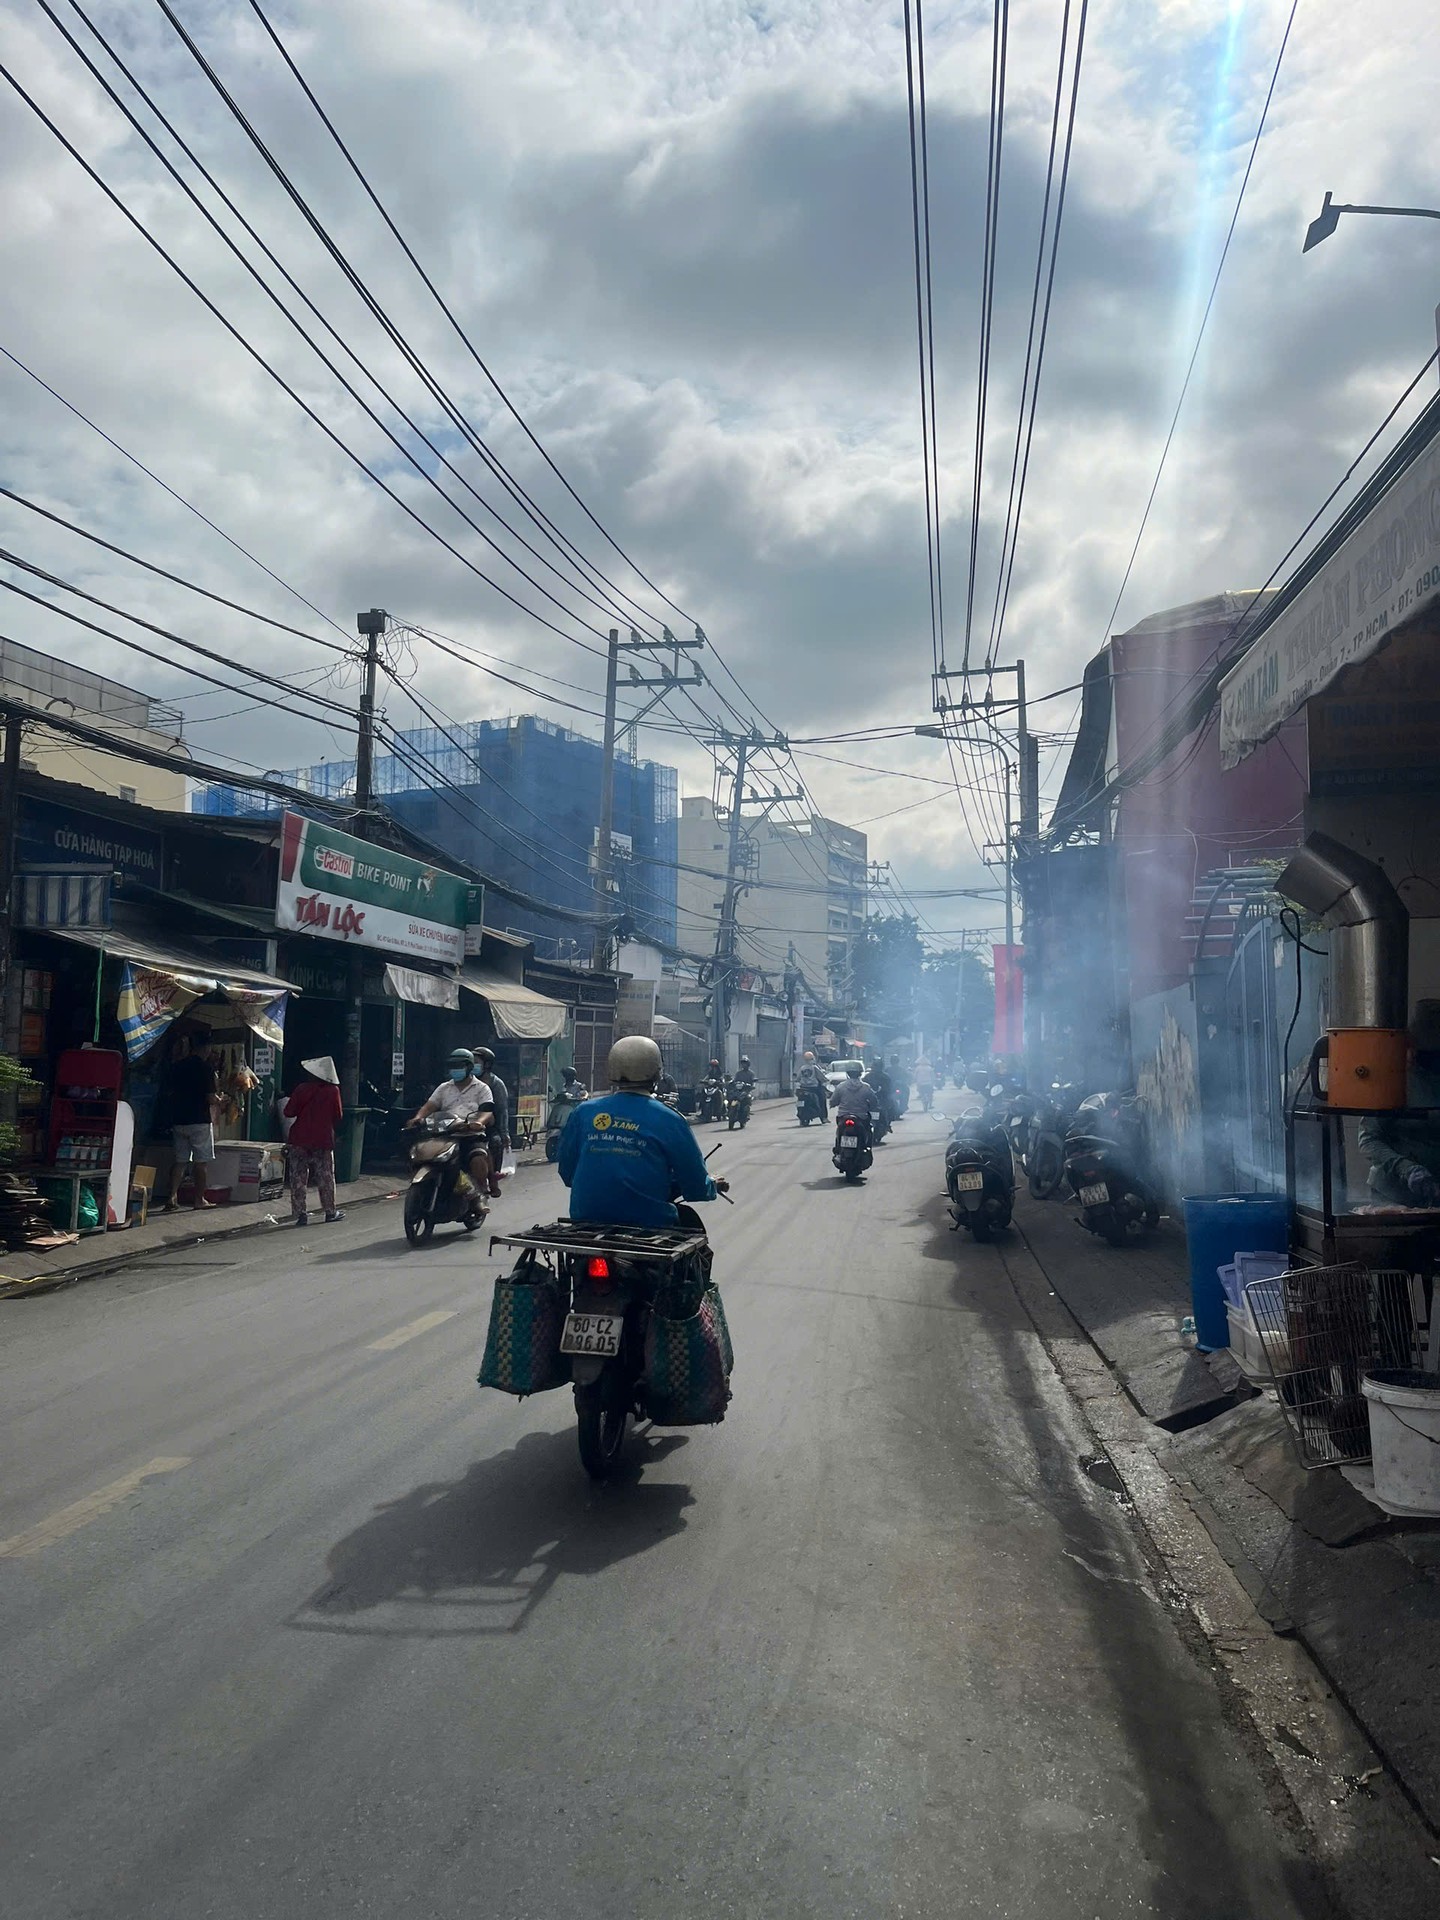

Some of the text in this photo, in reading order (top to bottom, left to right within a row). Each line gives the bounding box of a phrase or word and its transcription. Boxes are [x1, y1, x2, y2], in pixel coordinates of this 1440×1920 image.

[55, 825, 79, 851] CỬA
[81, 833, 112, 859] HÀNG
[114, 844, 132, 866] TẠP
[323, 850, 413, 893] Castrol BIKE POINT
[332, 904, 366, 940] LỘC
[612, 1120, 640, 1131] XANH
[574, 1318, 613, 1335] 60-C2
